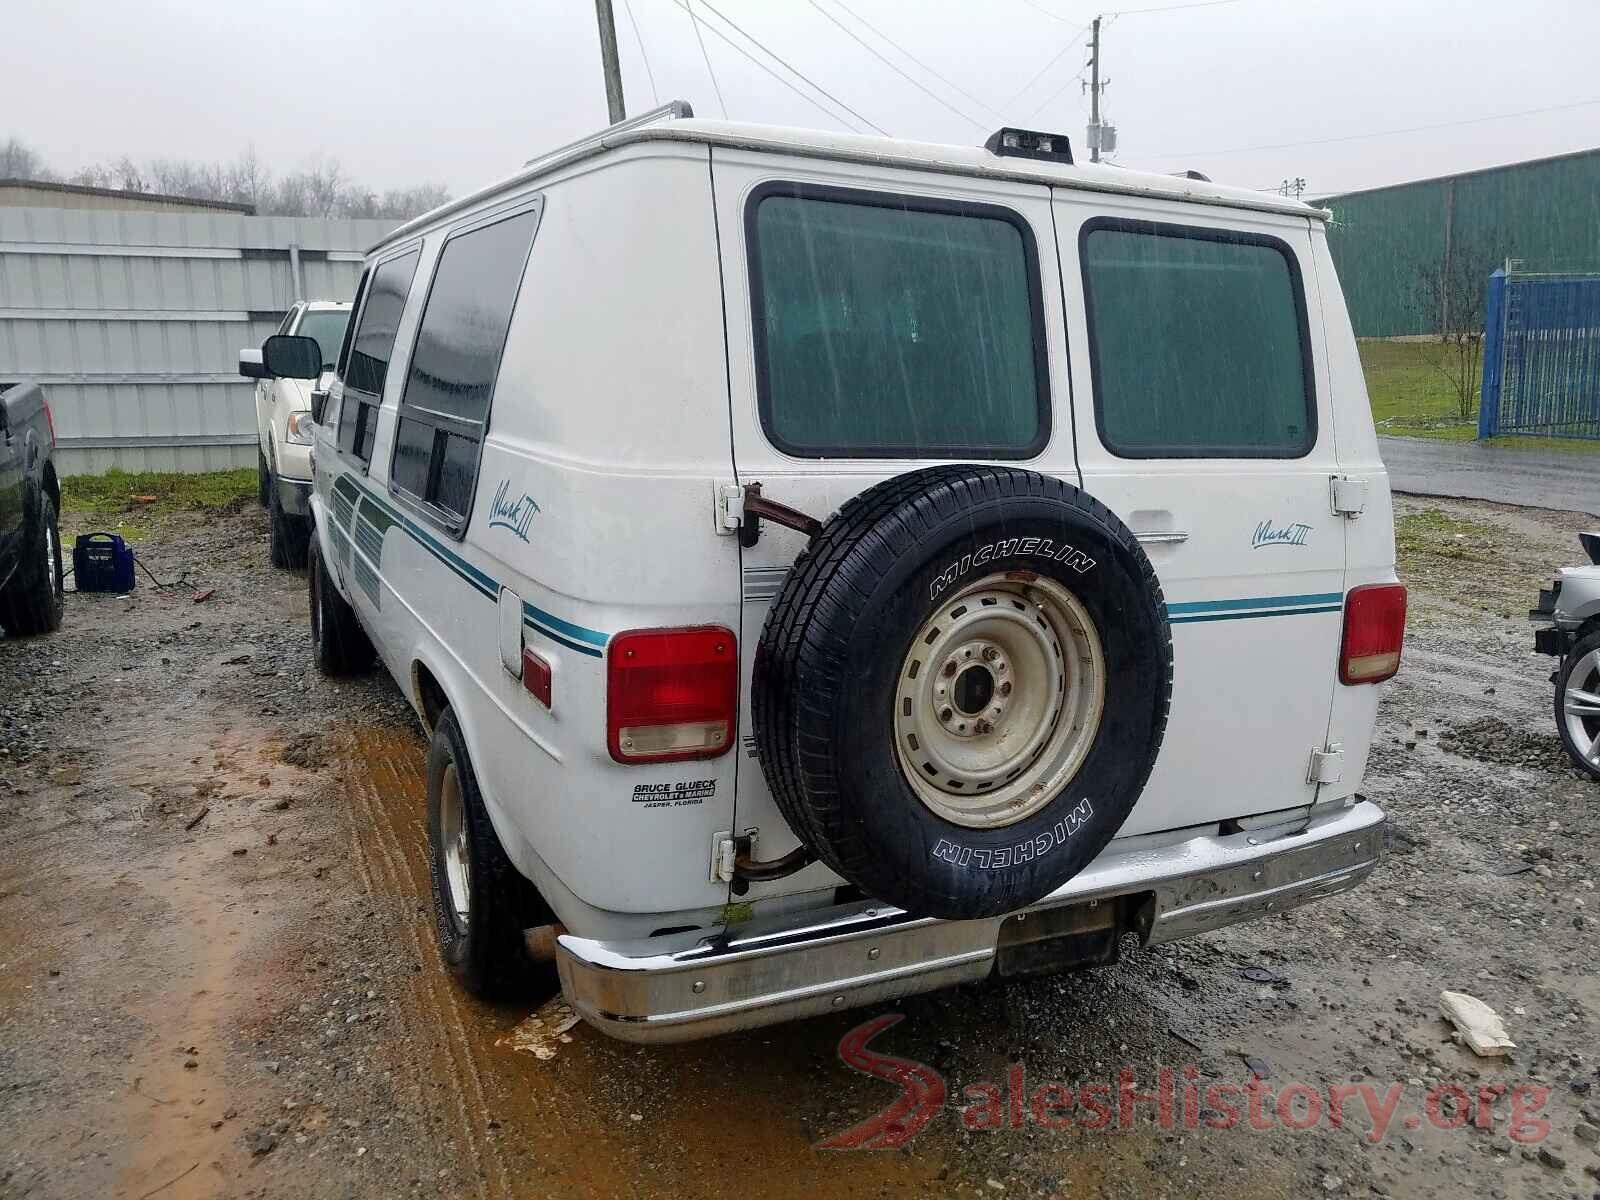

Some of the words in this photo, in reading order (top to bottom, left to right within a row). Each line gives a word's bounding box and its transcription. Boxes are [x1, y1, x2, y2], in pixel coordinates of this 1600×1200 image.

[488, 479, 526, 524] Mark
[1251, 519, 1296, 546] Mark
[929, 537, 1097, 600] MICHELIN
[633, 783, 671, 792] BRUCE
[675, 779, 718, 790] GLUECK
[633, 792, 680, 801] CHEVROLET
[685, 788, 715, 798] MARINE
[674, 798, 703, 806] FLORIDA
[932, 798, 1094, 868] MICHELIN
